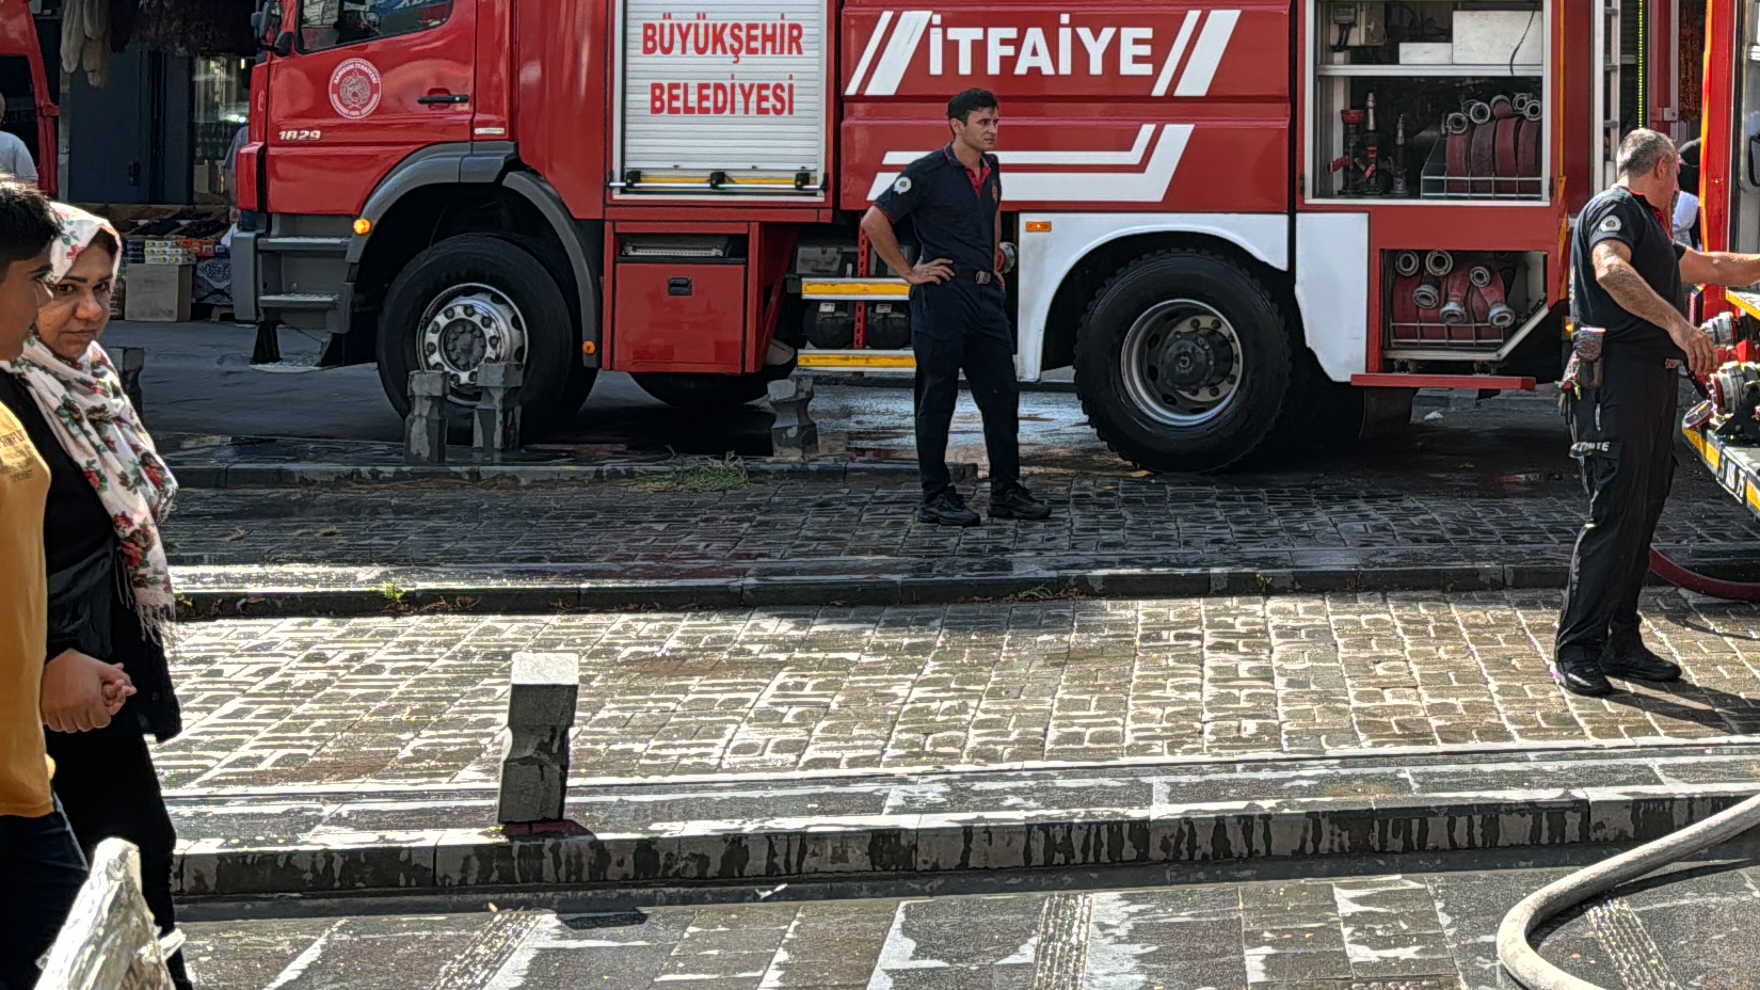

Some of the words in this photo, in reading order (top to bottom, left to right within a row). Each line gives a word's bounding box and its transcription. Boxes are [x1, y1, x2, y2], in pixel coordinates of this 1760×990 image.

[642, 12, 803, 64] BÜYÜKŞEHİR
[929, 13, 1154, 76] İTFAİYE
[650, 72, 795, 116] BELEDİYESİ
[278, 129, 322, 142] 1829
